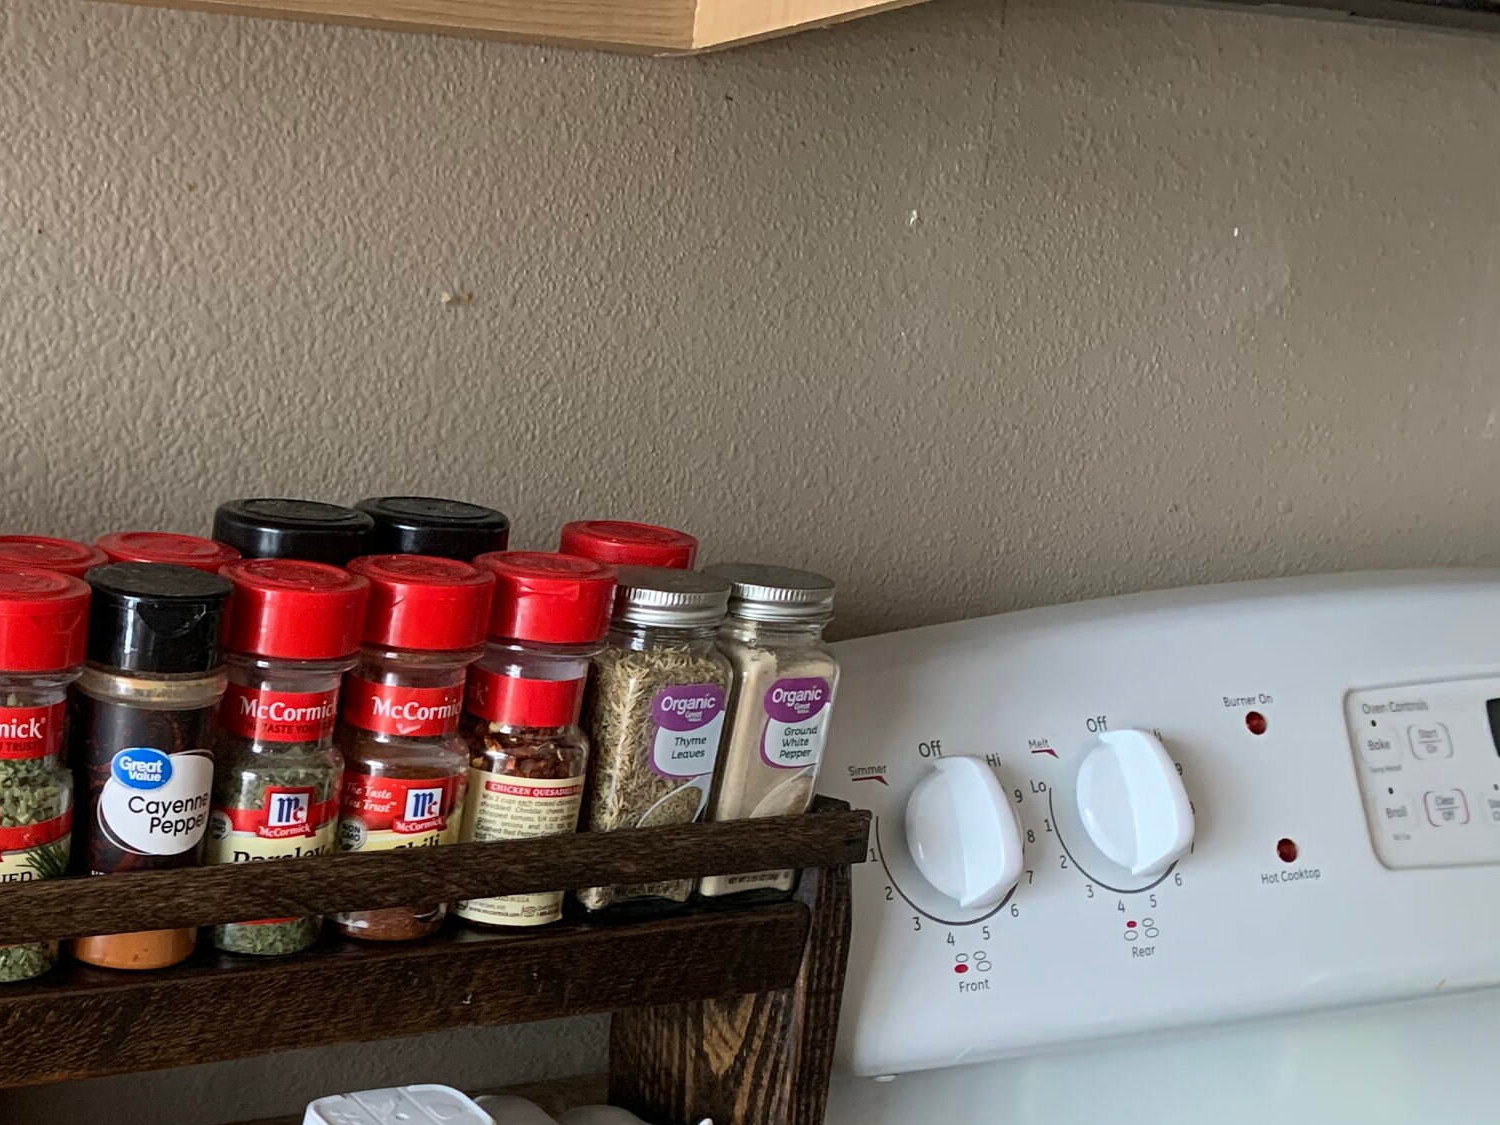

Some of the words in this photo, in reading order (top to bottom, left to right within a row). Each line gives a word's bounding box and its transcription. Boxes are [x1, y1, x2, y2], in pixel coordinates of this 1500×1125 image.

[772, 685, 822, 707] Organic
[1223, 695, 1257, 708] Burner
[1258, 693, 1273, 704] On
[661, 693, 716, 715] Organic
[1362, 702, 1386, 714] Oven
[784, 725, 818, 736] Ground
[1086, 716, 1108, 733] Off
[675, 736, 707, 748] Thyme
[782, 737, 809, 747] White
[918, 740, 942, 758] Off
[1028, 739, 1050, 748] Melt
[1367, 738, 1391, 750] Bake
[671, 749, 706, 760] Leaves
[779, 749, 812, 760] Pepper
[986, 753, 1001, 767] Hi
[120, 756, 163, 773] Great
[848, 764, 887, 776] Simmer
[128, 772, 162, 782] Value
[365, 786, 393, 800] Taste
[491, 784, 530, 796] CHICKEN
[1030, 780, 1047, 794] Lo
[1014, 789, 1024, 803] 9
[128, 792, 209, 818] Cayenne
[363, 800, 391, 814] Trust
[259, 824, 312, 838] McCormick
[396, 818, 443, 833] McCormick
[1044, 819, 1052, 832] 1
[1027, 830, 1036, 843] 8
[870, 848, 878, 862] 1
[1060, 855, 1068, 869] 2
[1026, 871, 1034, 884] 7
[1174, 873, 1182, 886] 6
[1261, 872, 1280, 885] Hot
[1280, 868, 1321, 882] Cooktop
[884, 886, 894, 901] 2
[1086, 884, 1094, 898] 3
[1117, 900, 1126, 912] 4
[1150, 895, 1157, 908] 5
[1010, 904, 1019, 918] 6
[913, 917, 922, 931] 3
[946, 932, 955, 946] 4
[982, 926, 990, 940] 5
[1132, 946, 1156, 958] Rear
[958, 978, 990, 994] Front
